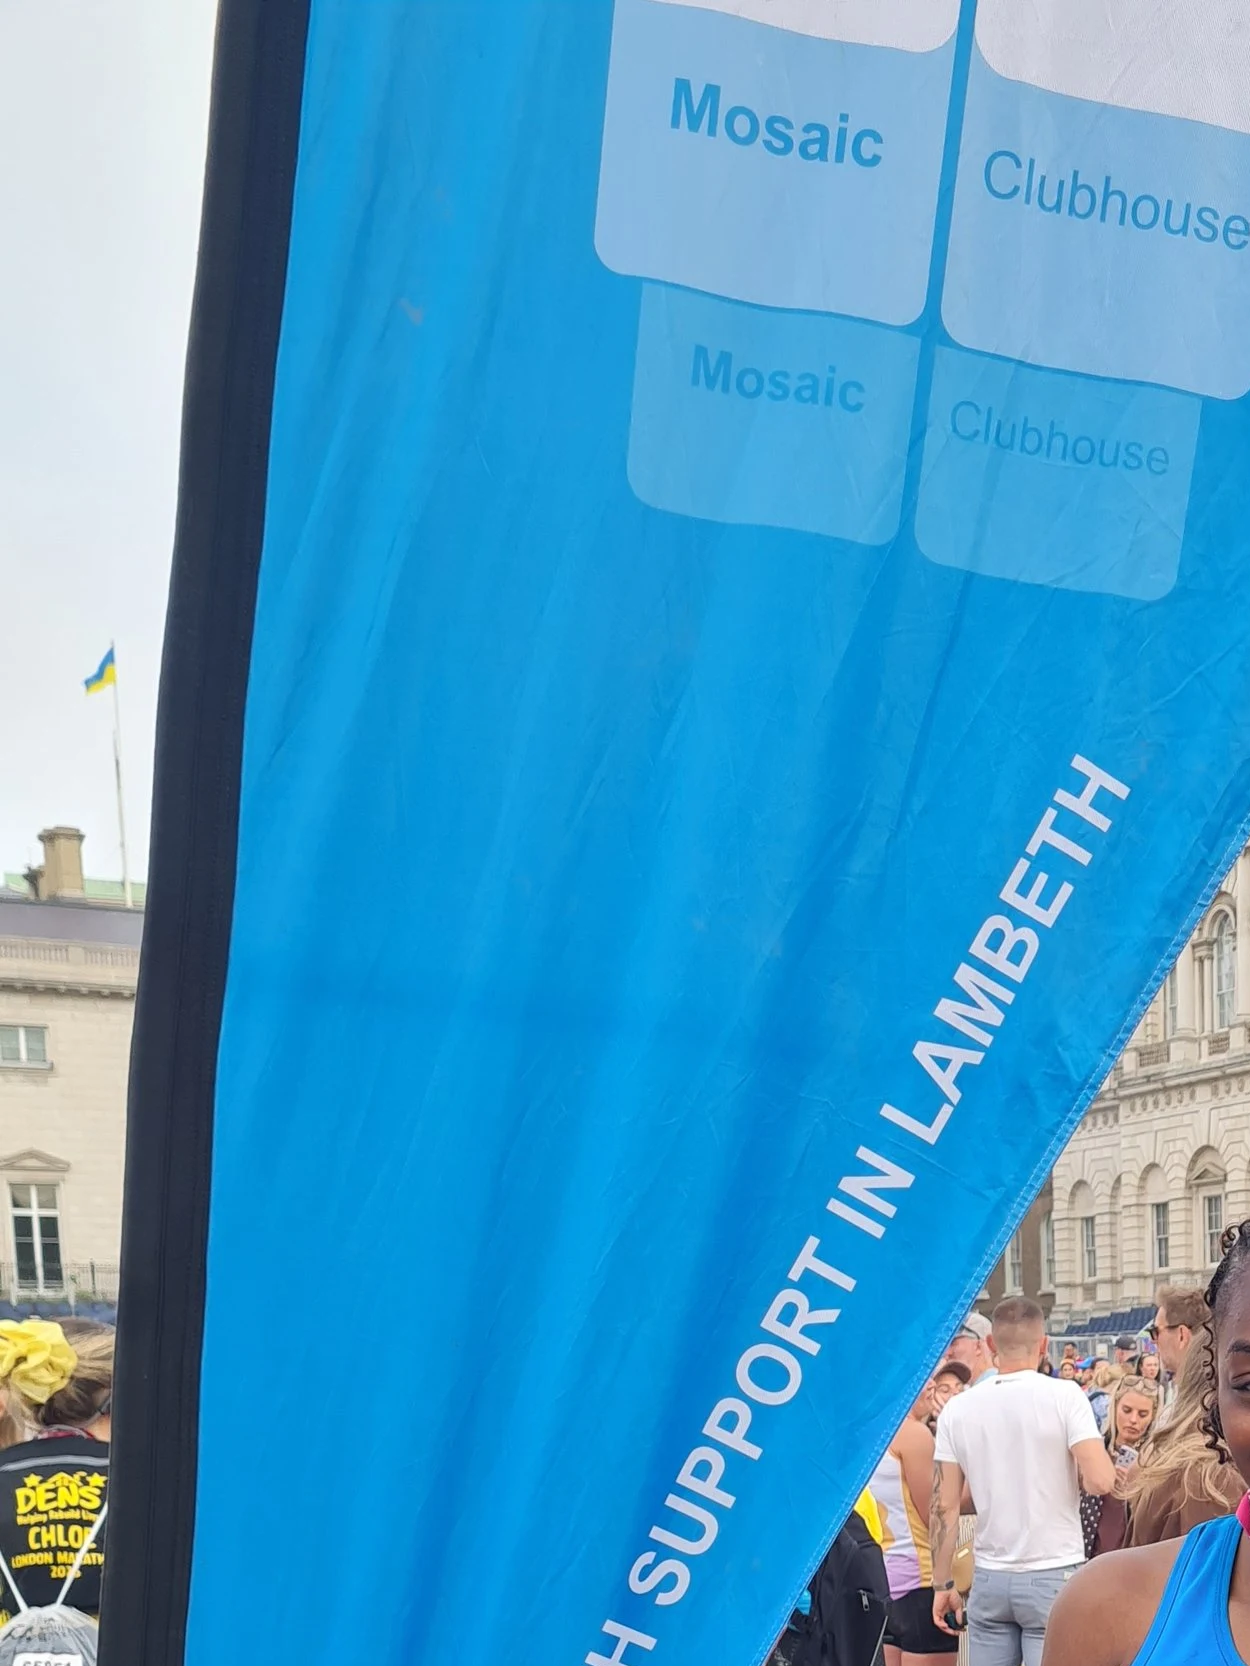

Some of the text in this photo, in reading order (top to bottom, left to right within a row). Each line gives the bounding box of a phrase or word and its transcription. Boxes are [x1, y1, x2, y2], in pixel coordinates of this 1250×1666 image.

[669, 77, 884, 169] Mosaic
[690, 342, 866, 414] Mosaic
[948, 398, 1171, 476] Clubhouse
[628, 1235, 857, 1607] SUPPORT
[826, 1146, 916, 1239] IN
[880, 753, 1131, 1145] LAMBETH
[16, 1482, 101, 1514] DENS
[11, 1551, 54, 1569] LONDON
[28, 1524, 97, 1551] CHLOE
